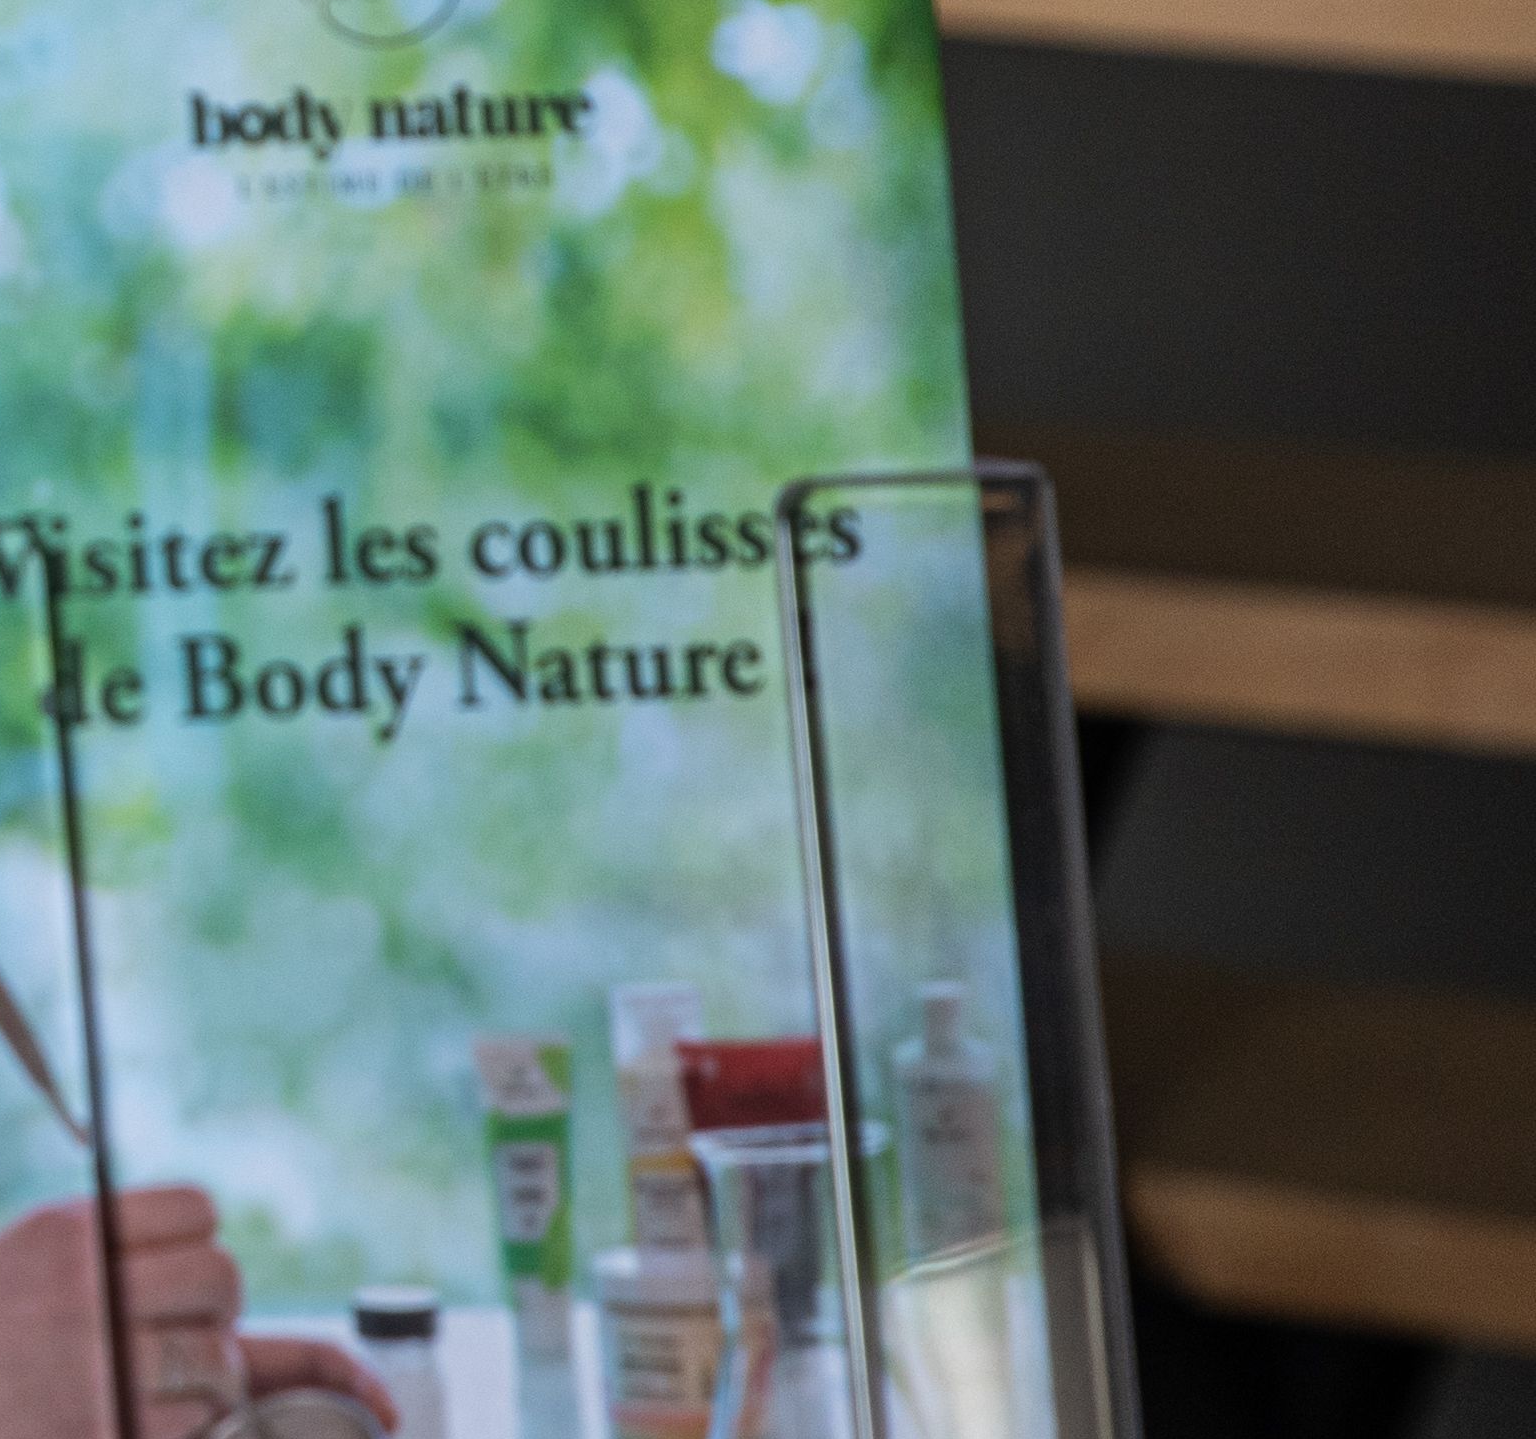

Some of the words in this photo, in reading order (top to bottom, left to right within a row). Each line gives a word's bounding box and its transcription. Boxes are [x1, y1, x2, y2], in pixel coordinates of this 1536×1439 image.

[189, 85, 342, 161] body
[370, 81, 595, 139] nature
[320, 494, 438, 588] les
[470, 482, 863, 580] coulisses
[177, 623, 425, 742] Body
[456, 619, 767, 710] Nature
